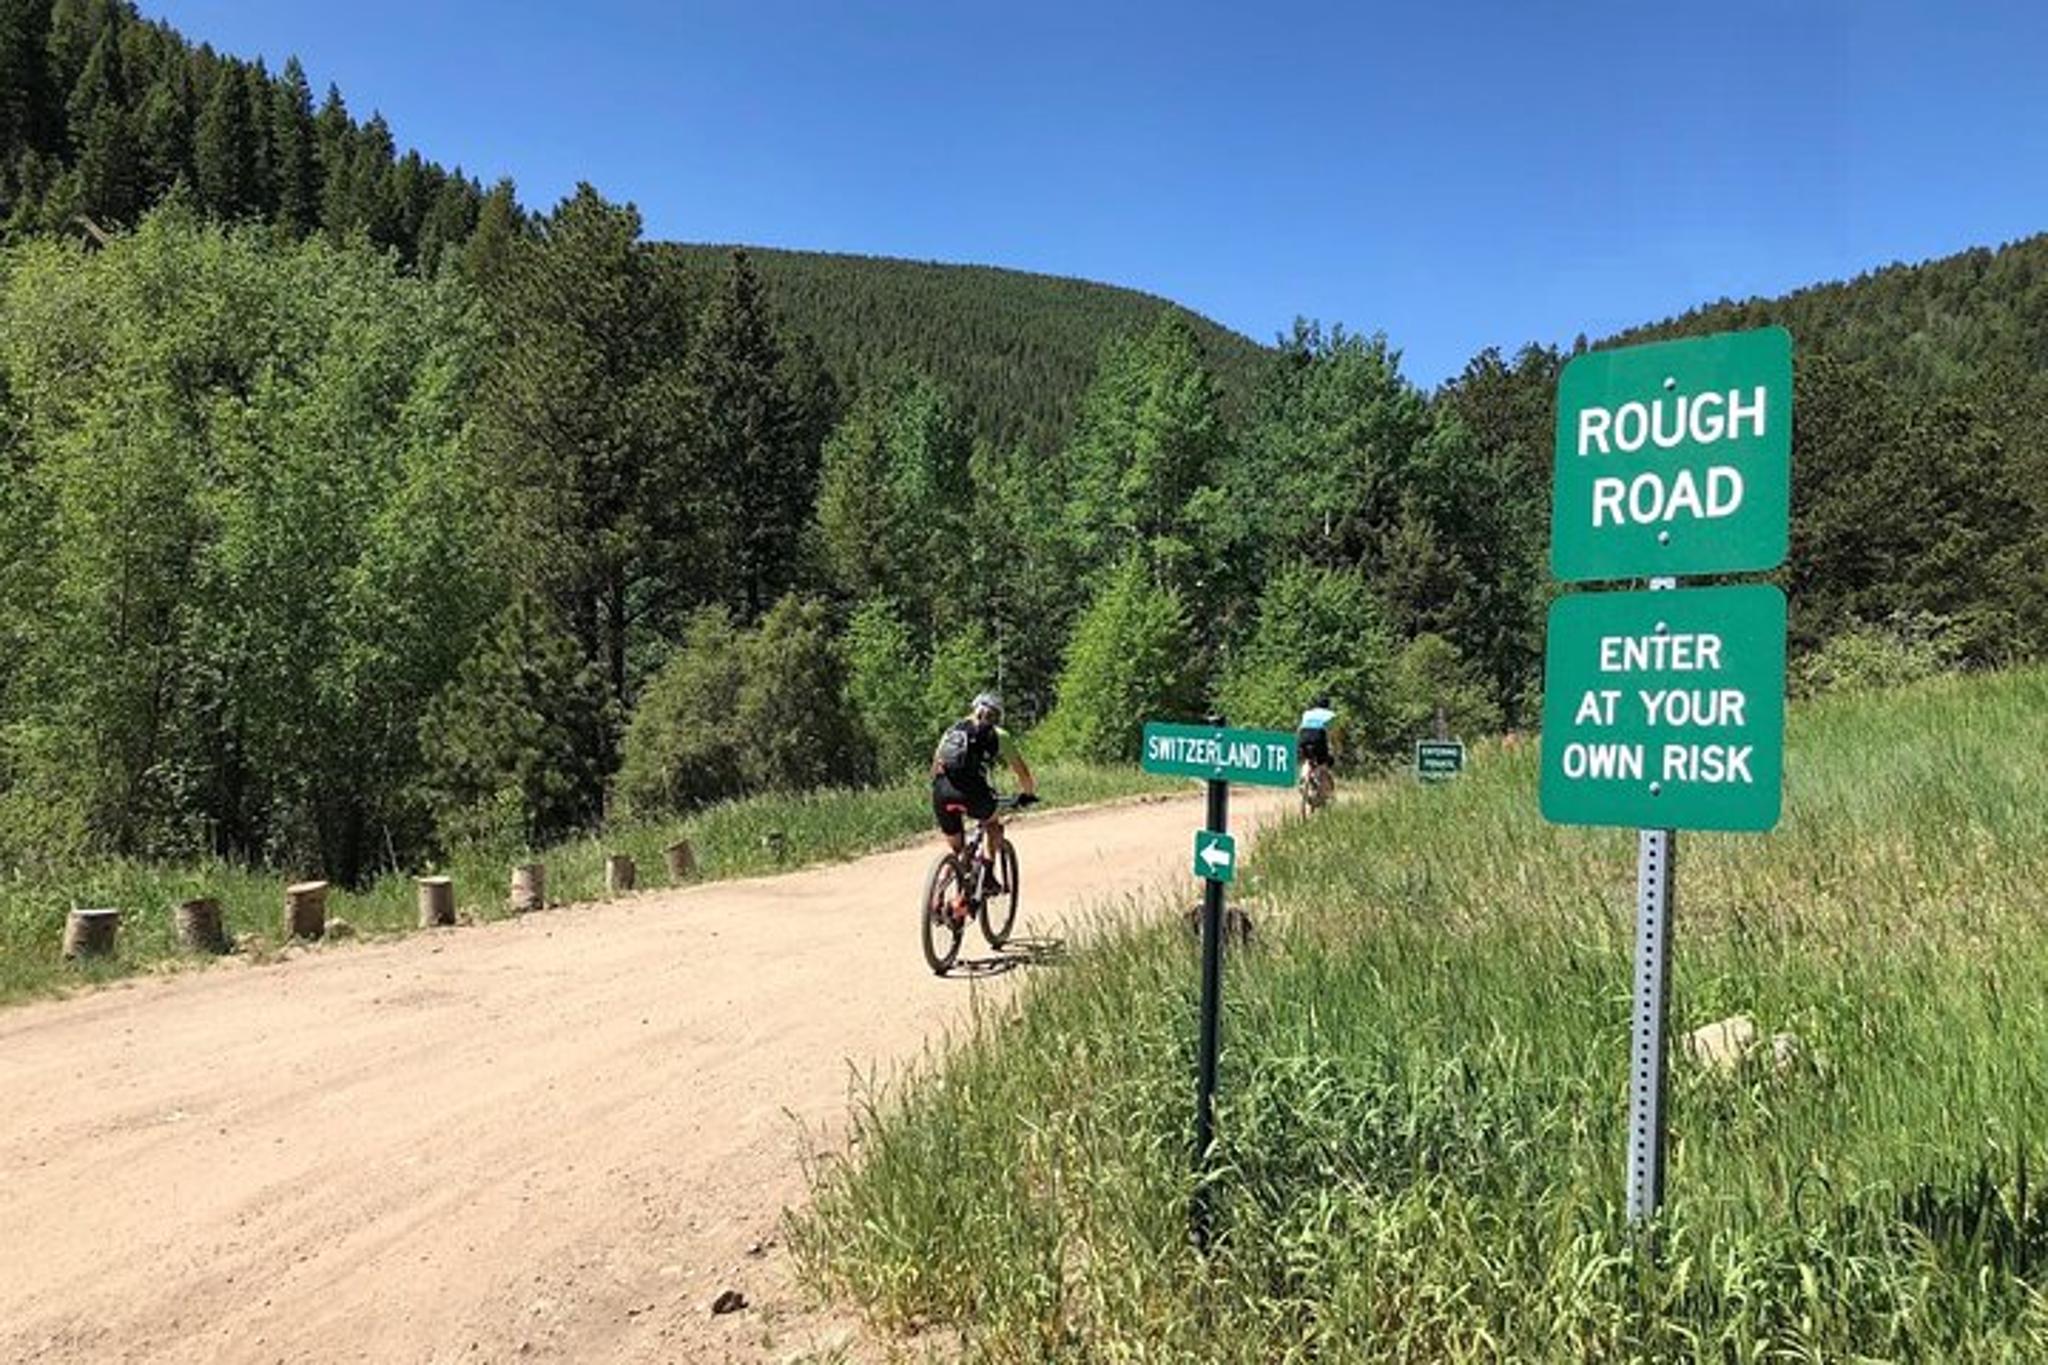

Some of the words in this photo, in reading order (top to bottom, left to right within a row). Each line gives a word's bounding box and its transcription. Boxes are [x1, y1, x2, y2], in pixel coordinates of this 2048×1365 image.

[1577, 387, 1766, 456] ROUGH
[1592, 466, 1744, 528] ROAD
[1600, 634, 1721, 672] ENTER
[1575, 690, 1621, 726] AT
[1639, 690, 1745, 726] YOUR
[1149, 736, 1261, 769] SWITZERLAND
[1266, 745, 1288, 772] TR
[1562, 744, 1644, 779] OWN
[1663, 744, 1753, 783] RISK
